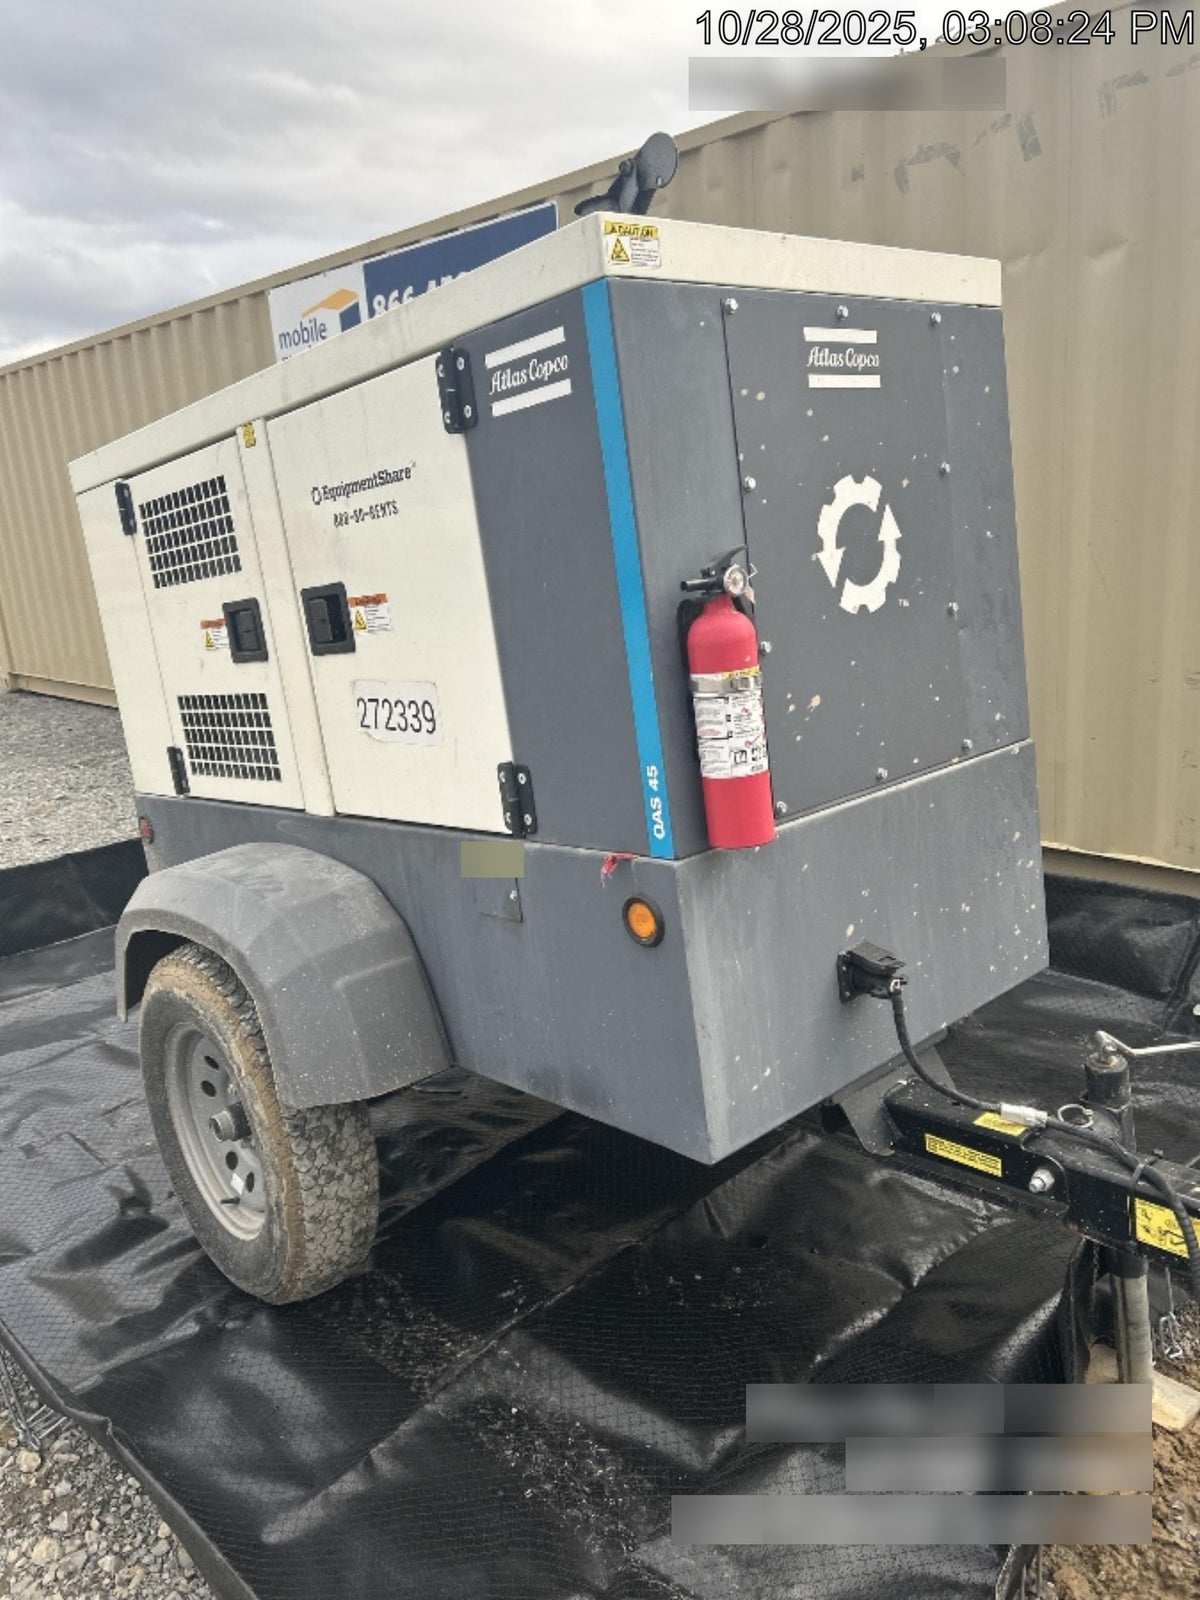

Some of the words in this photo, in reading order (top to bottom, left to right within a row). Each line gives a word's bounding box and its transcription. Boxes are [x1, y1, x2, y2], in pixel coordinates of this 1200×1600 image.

[278, 317, 328, 349] mobile
[488, 367, 528, 396] Atlas
[528, 354, 569, 382] Copco
[806, 346, 844, 368] Atlas
[845, 347, 880, 373] Copco
[321, 466, 412, 502] EquipmentShare
[356, 696, 437, 735] 272339
[646, 765, 659, 792] 45
[649, 796, 666, 840] QAS
